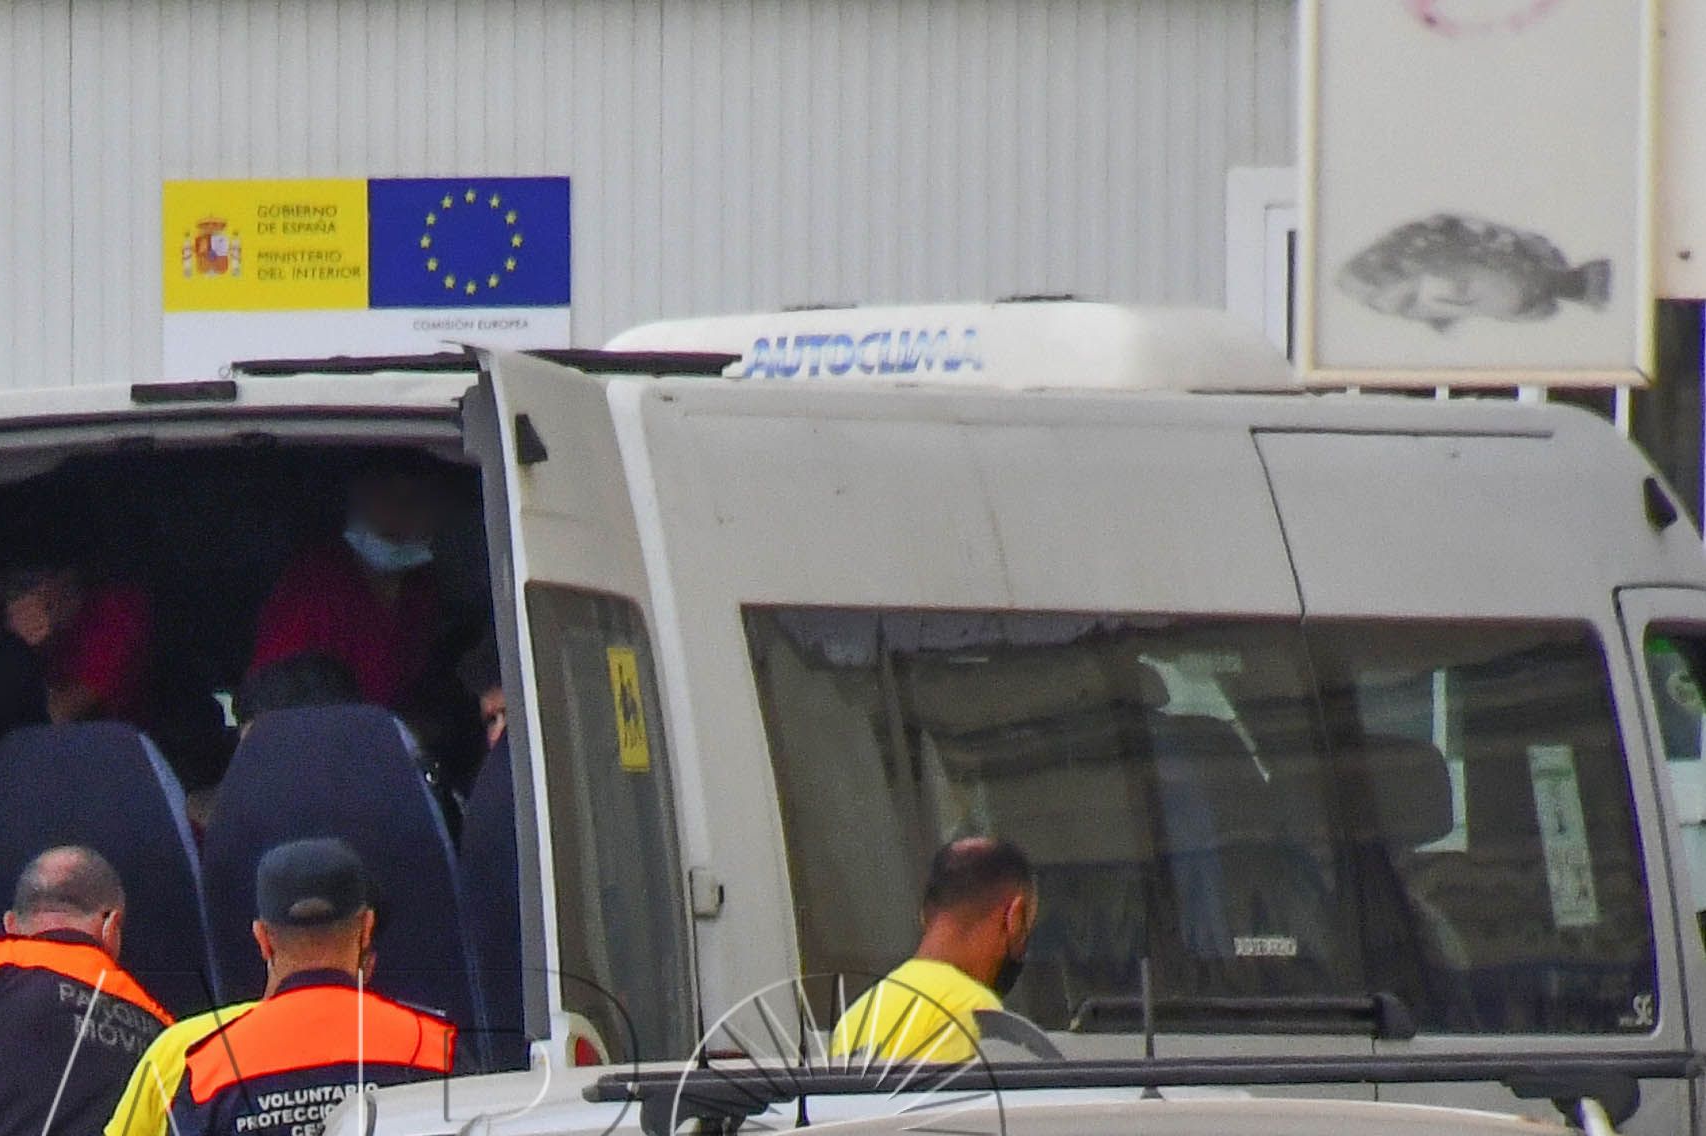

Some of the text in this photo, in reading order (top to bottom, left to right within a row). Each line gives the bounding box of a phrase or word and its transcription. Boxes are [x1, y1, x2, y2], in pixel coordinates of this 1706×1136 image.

[256, 204, 338, 218] GOBIERNO
[256, 219, 336, 234] DE ESPAÑA
[256, 249, 343, 264] MINISTERIO
[256, 266, 361, 281] DEL INTERIOR
[742, 327, 983, 379] AUTOCLIMA
[257, 1082, 378, 1112] VOLUNTARO
